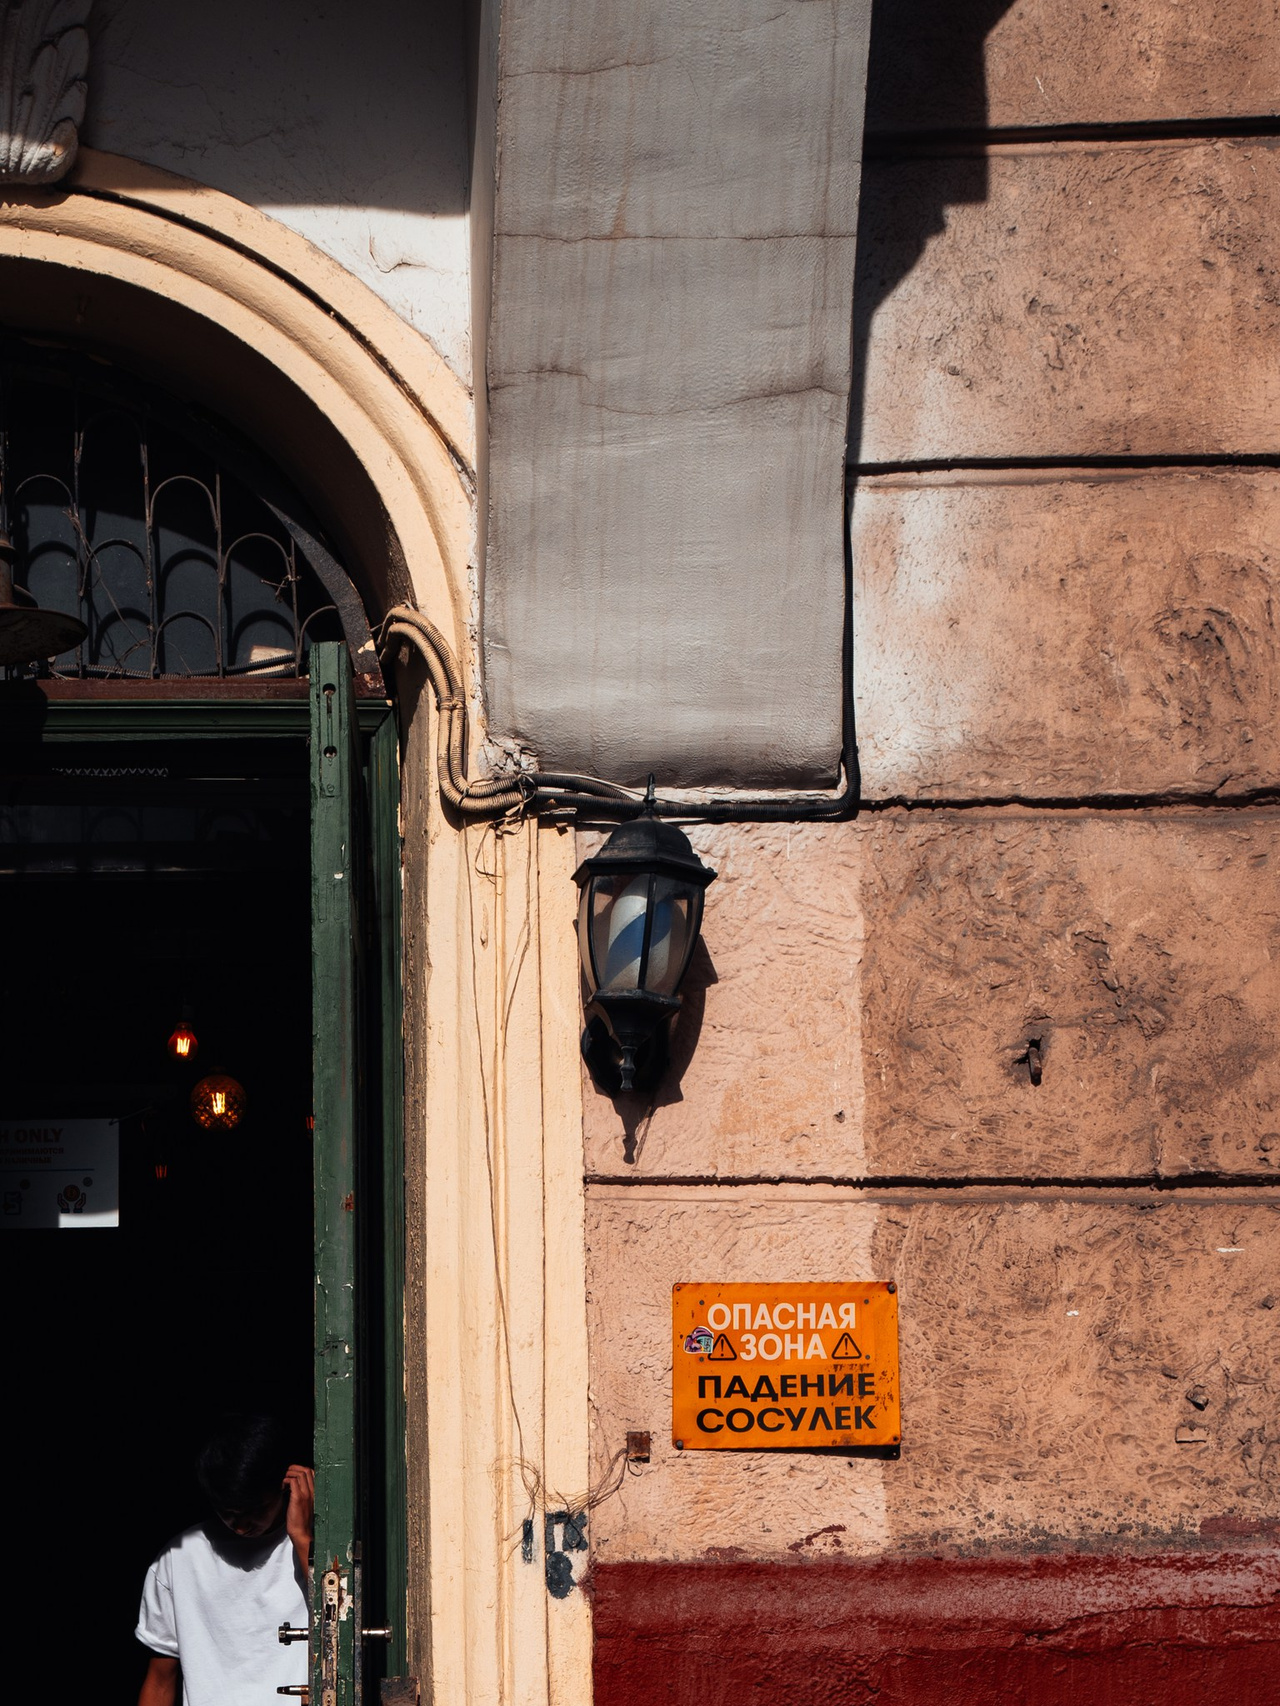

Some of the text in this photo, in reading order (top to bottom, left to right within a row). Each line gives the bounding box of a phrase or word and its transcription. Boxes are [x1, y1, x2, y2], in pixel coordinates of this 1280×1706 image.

[14, 1128, 64, 1143] ONLY
[707, 1303, 856, 1330] ОПАСНАЯ
[740, 1334, 827, 1361] ЗОНА
[698, 1373, 875, 1402] ПАДЕНИЕ
[696, 1405, 876, 1432] СОСУЛЕК
